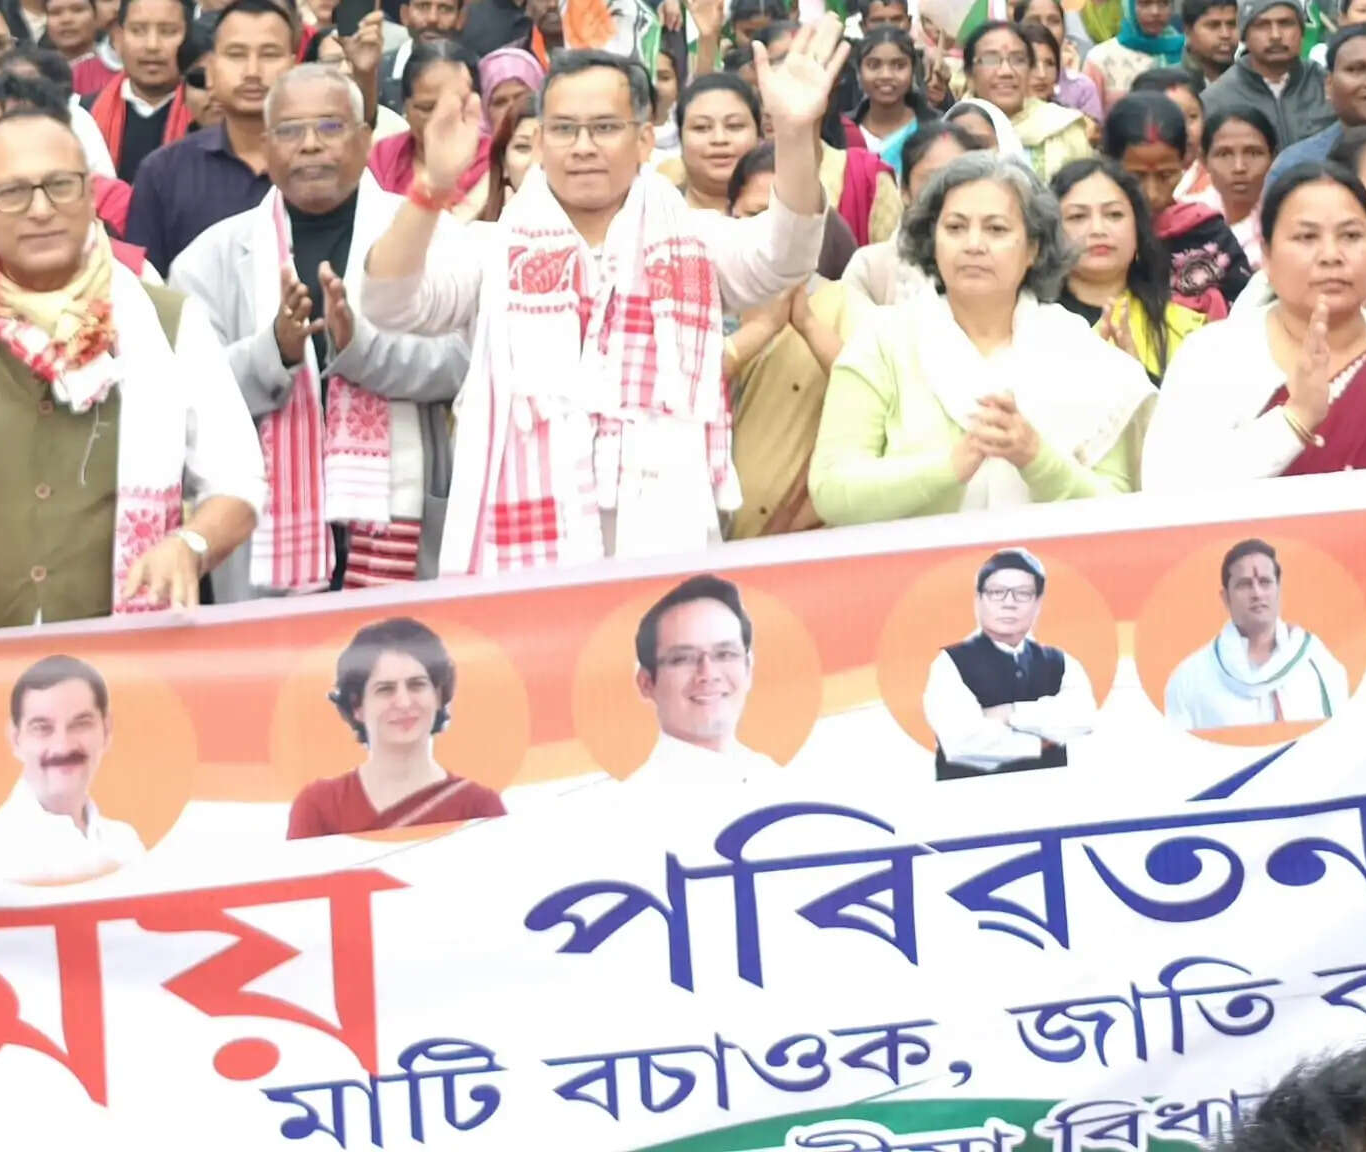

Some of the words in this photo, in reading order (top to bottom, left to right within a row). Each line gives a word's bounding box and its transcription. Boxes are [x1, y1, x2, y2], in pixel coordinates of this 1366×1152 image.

[260, 1037, 509, 1149] মাটি
[545, 1019, 973, 1123] বচাওক,
[1008, 955, 1285, 1066] জাতি
